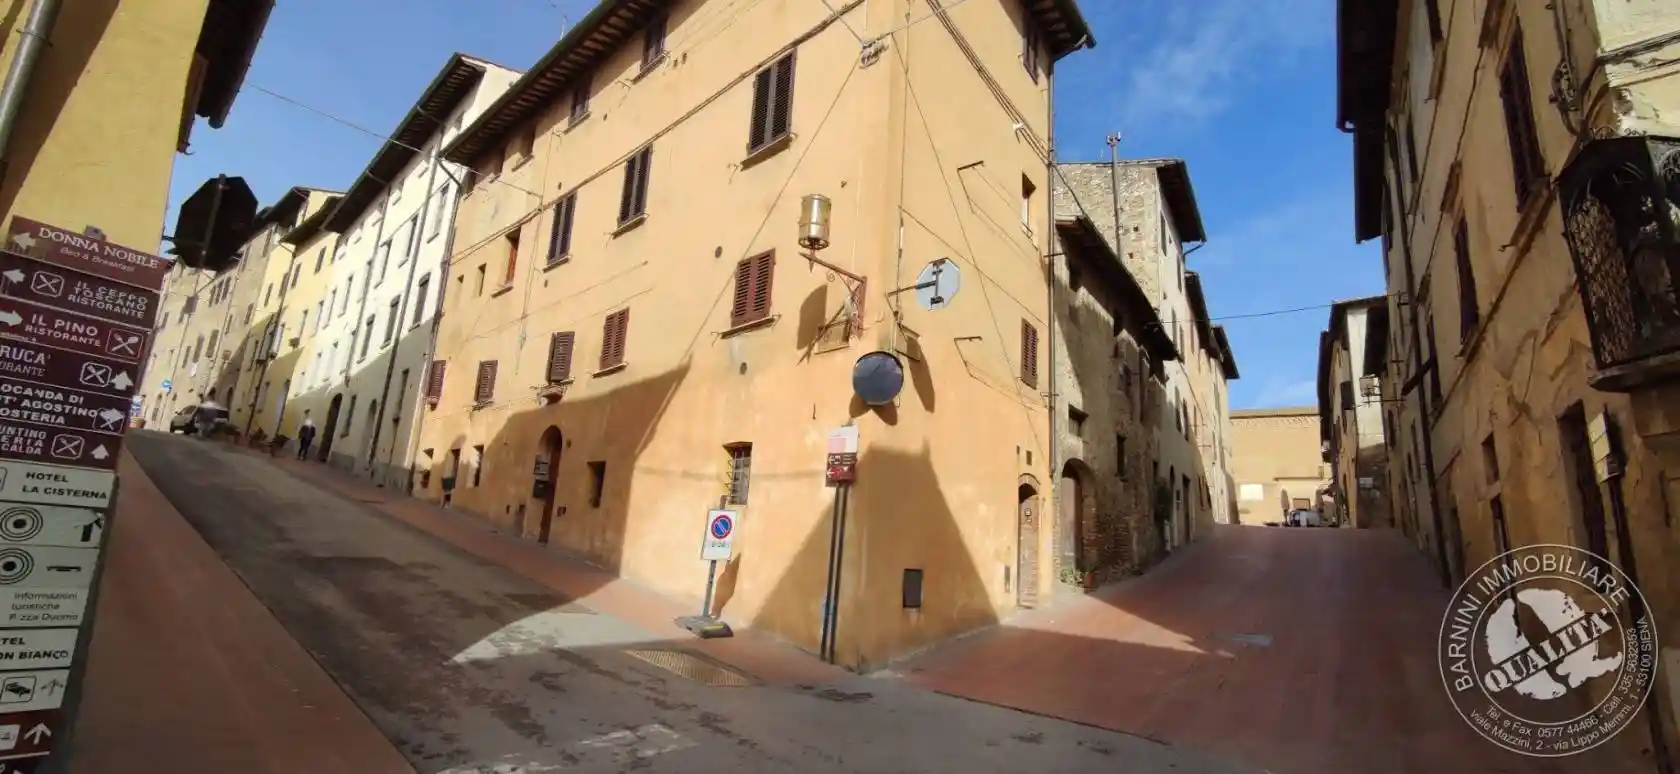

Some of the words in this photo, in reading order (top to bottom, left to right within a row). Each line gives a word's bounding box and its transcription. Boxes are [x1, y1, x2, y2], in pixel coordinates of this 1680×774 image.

[38, 227, 100, 253] DONNA
[104, 246, 160, 269] NOBILE
[74, 286, 146, 310] TOSCANO
[98, 286, 148, 304] CEPPO
[67, 294, 145, 319] RISTORANTE
[31, 313, 47, 326] IL
[54, 319, 99, 336] PINO
[24, 325, 101, 347] RISTORANTE
[0, 384, 64, 401] OCANDA
[69, 395, 84, 405] DI
[0, 407, 65, 425] OSTERIA
[21, 399, 98, 417] AGOSTINO
[1, 443, 42, 455] CALDA
[26, 472, 68, 483] HOTEL
[22, 485, 39, 493] LA
[43, 487, 107, 499] CISTERNA
[14, 592, 78, 600] Informazioni
[41, 613, 79, 621] Duomo
[18, 650, 69, 660] BIANCO
